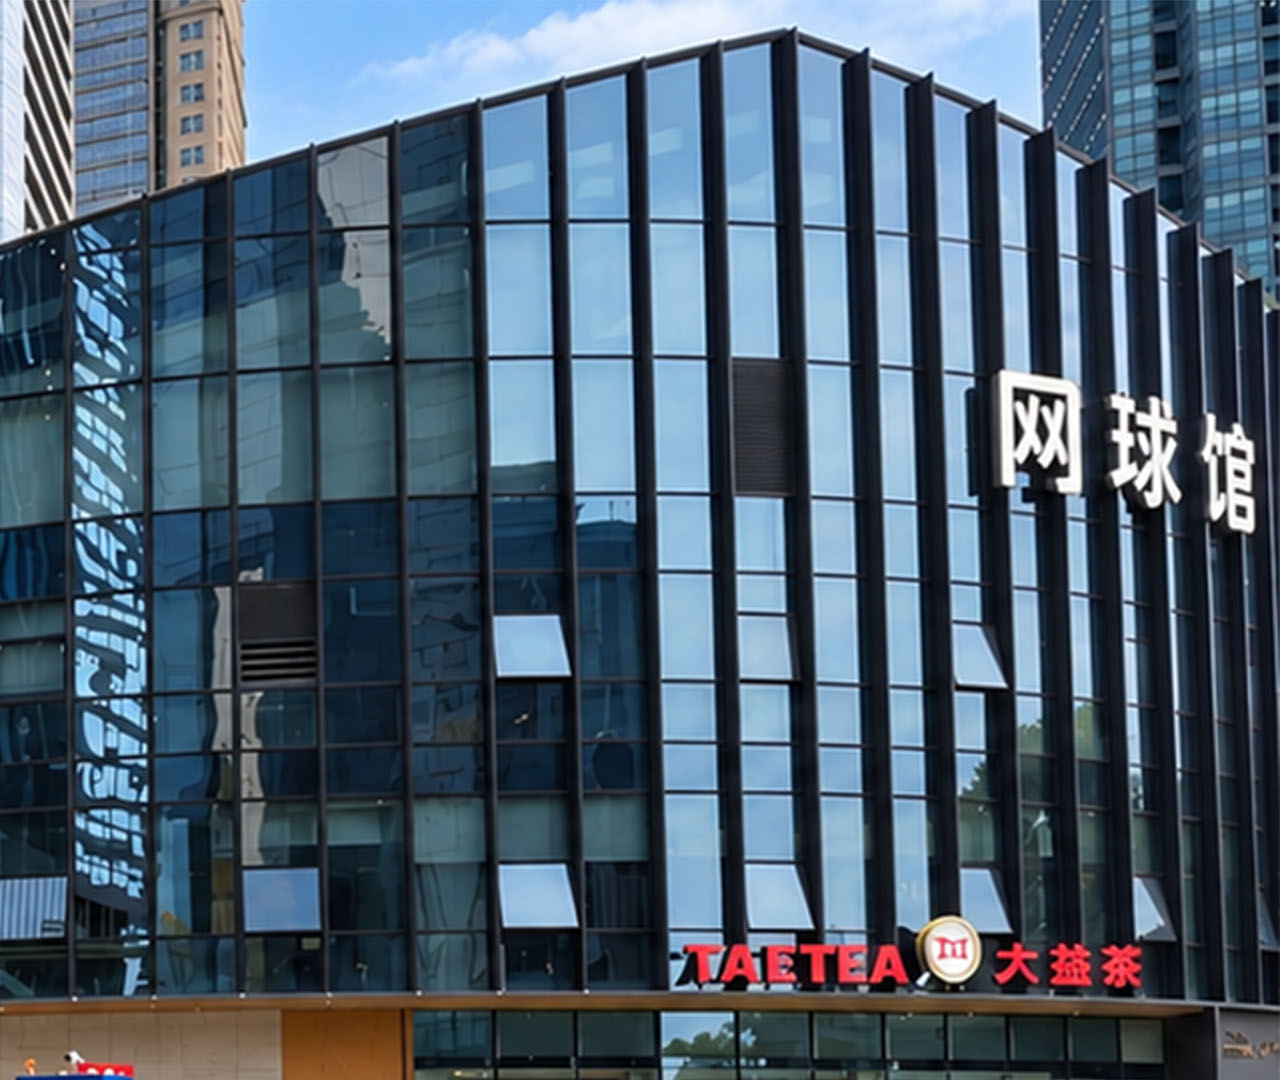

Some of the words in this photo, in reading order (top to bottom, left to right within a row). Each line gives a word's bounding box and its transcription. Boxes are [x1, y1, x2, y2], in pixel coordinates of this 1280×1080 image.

[992, 369, 1257, 535] 网球馆
[684, 944, 910, 986] TAETEA
[994, 942, 1143, 988] 大益茶
